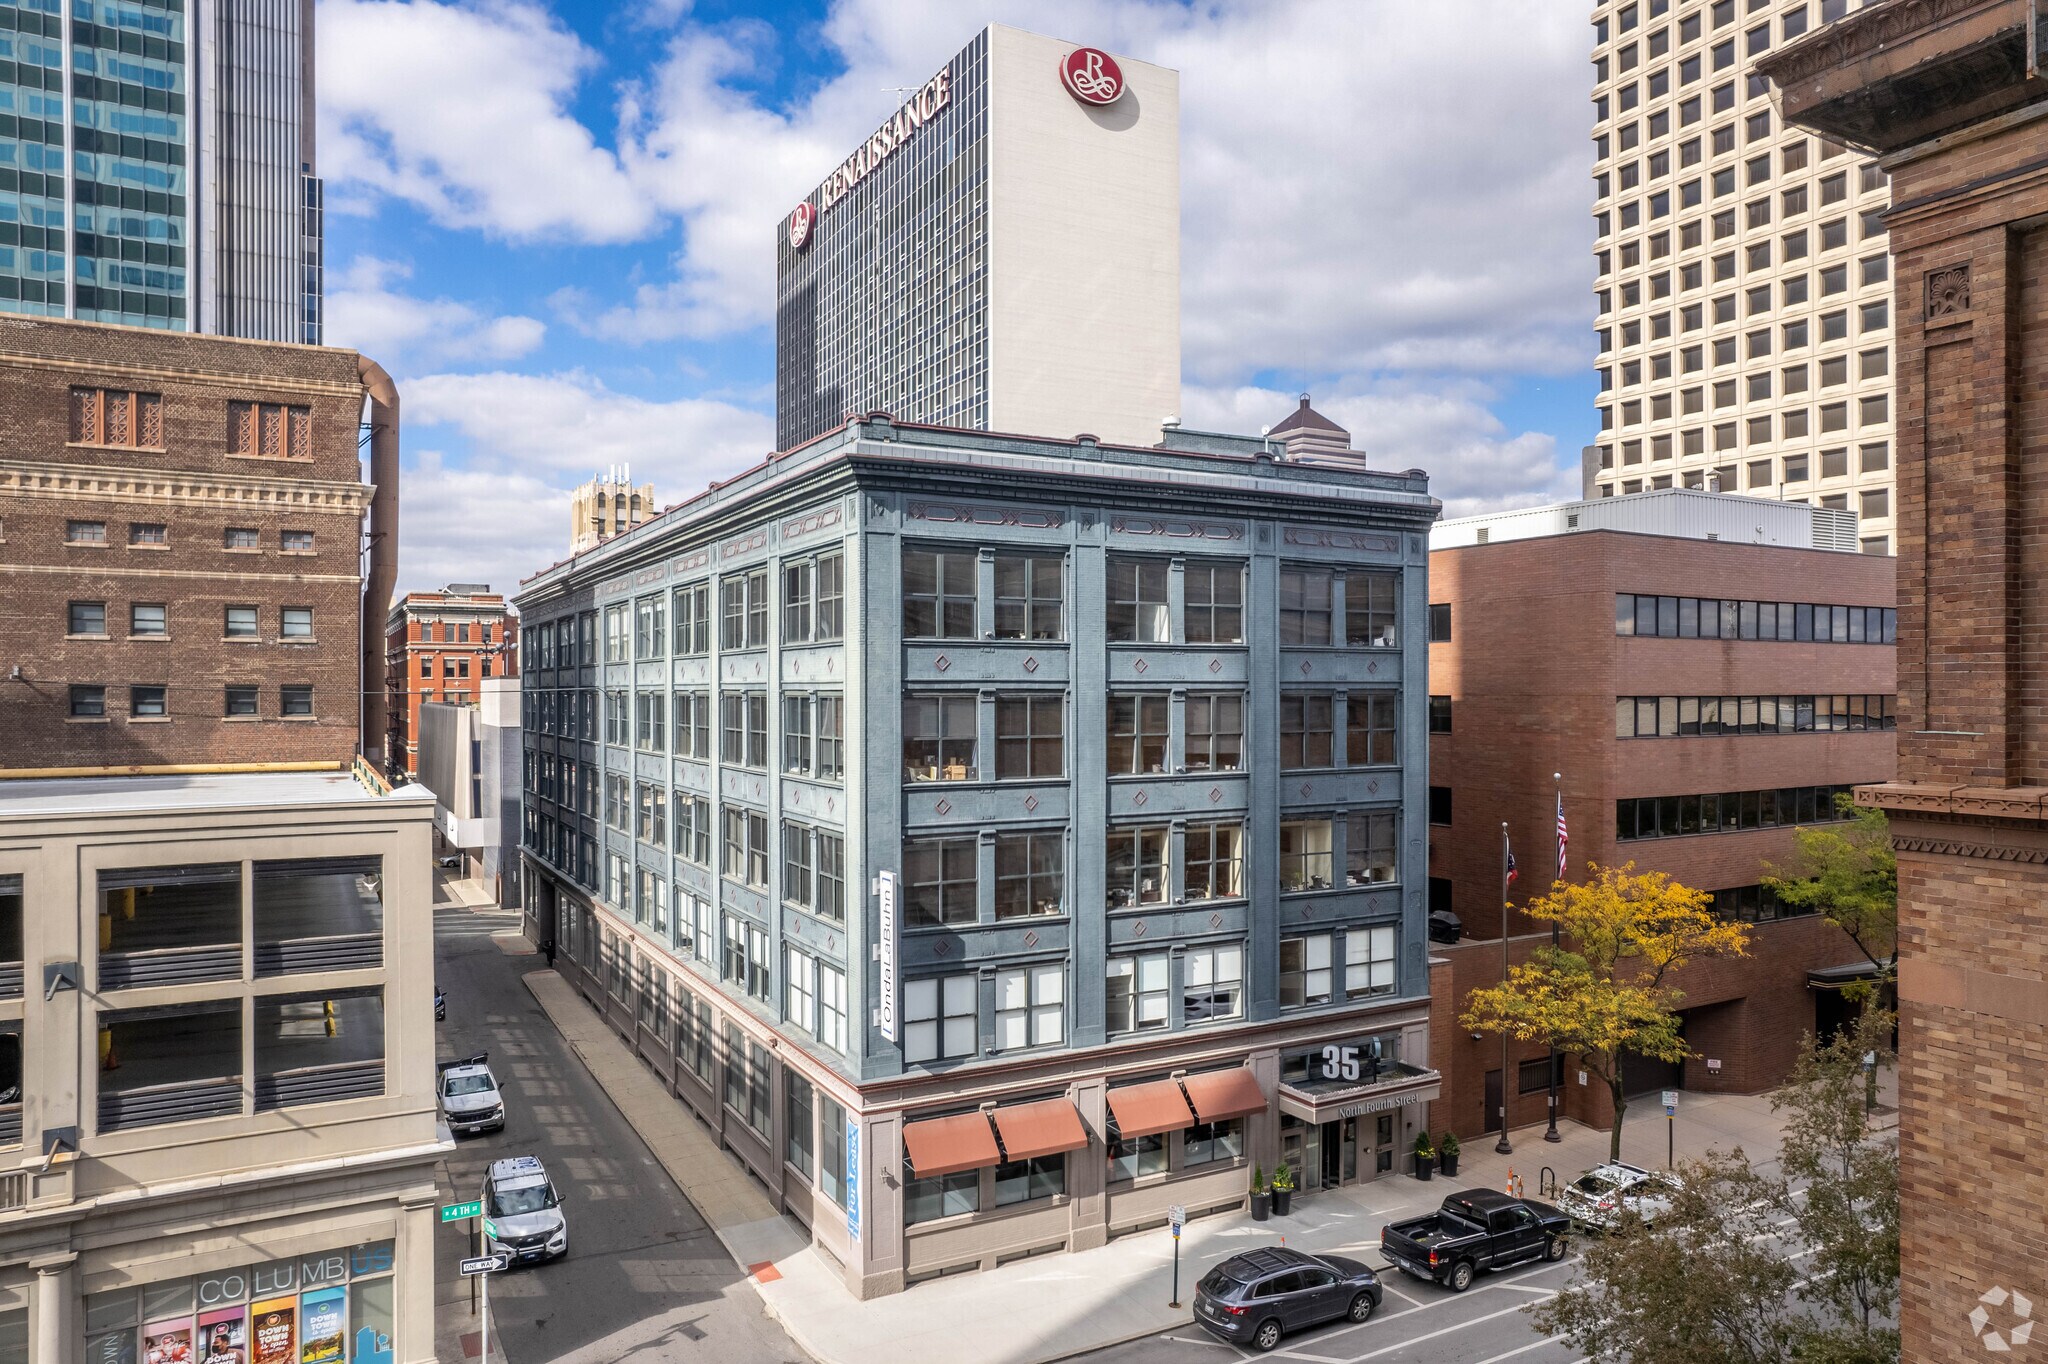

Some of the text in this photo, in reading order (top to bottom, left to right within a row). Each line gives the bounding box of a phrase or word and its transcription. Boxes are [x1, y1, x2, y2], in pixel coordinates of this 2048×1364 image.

[821, 67, 950, 214] RENAISSANCE
[1322, 1045, 1360, 1080] 35
[1339, 1093, 1419, 1118] North Fourth Street
[848, 1184, 857, 1215] For
[480, 1260, 495, 1268] WAY
[310, 1312, 338, 1324] DOWN
[258, 1324, 290, 1337] DOWN
[310, 1320, 337, 1331] TOWN
[259, 1332, 289, 1344] TOWN
[270, 1339, 289, 1349] open
[206, 1352, 237, 1364] DOWN
